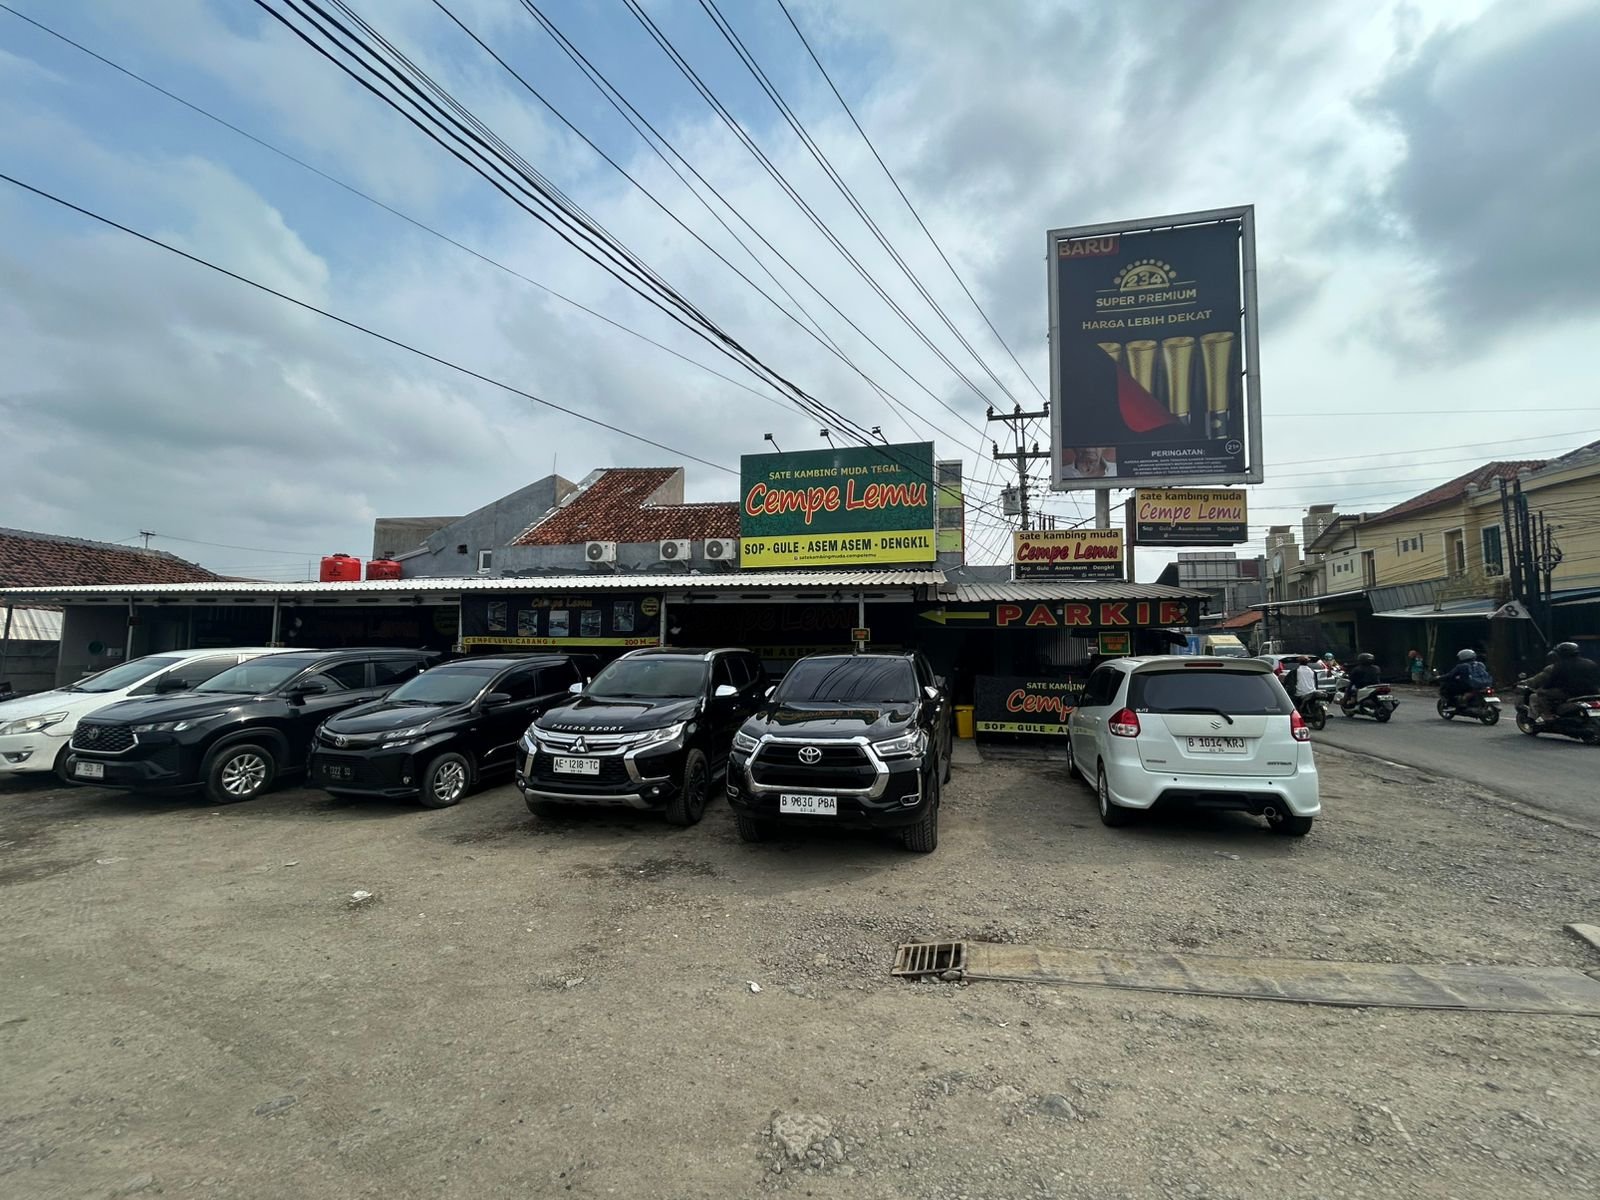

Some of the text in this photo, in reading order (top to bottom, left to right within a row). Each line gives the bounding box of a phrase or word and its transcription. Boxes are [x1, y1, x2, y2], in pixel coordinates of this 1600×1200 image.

[1059, 238, 1113, 256] BARU
[1127, 271, 1162, 288] 234
[1096, 289, 1197, 307] SUPER PREMIUM
[1082, 310, 1212, 330] HARGA LEBIH DEKAT
[1151, 449, 1206, 457] PERINGATAN:
[769, 464, 901, 481] SATE KAMBING MUDA TEGAL
[745, 479, 927, 525] Cempe Lemu
[1141, 492, 1242, 502] sate kambing muda
[1139, 502, 1242, 527] Cempe Lemu
[1020, 530, 1119, 540] sate kambing muda
[744, 536, 930, 555] SOP GULE ASEM ASEM DENGKIL
[1017, 542, 1119, 566] Cempe Lemu
[531, 598, 564, 610] Cepe
[996, 601, 1189, 626] PARKIR
[1006, 689, 1076, 722] Cemp
[1017, 724, 1046, 732] GULE
[1188, 737, 1195, 747] B
[554, 759, 598, 770] AE 1218 TC
[782, 796, 787, 806] B
